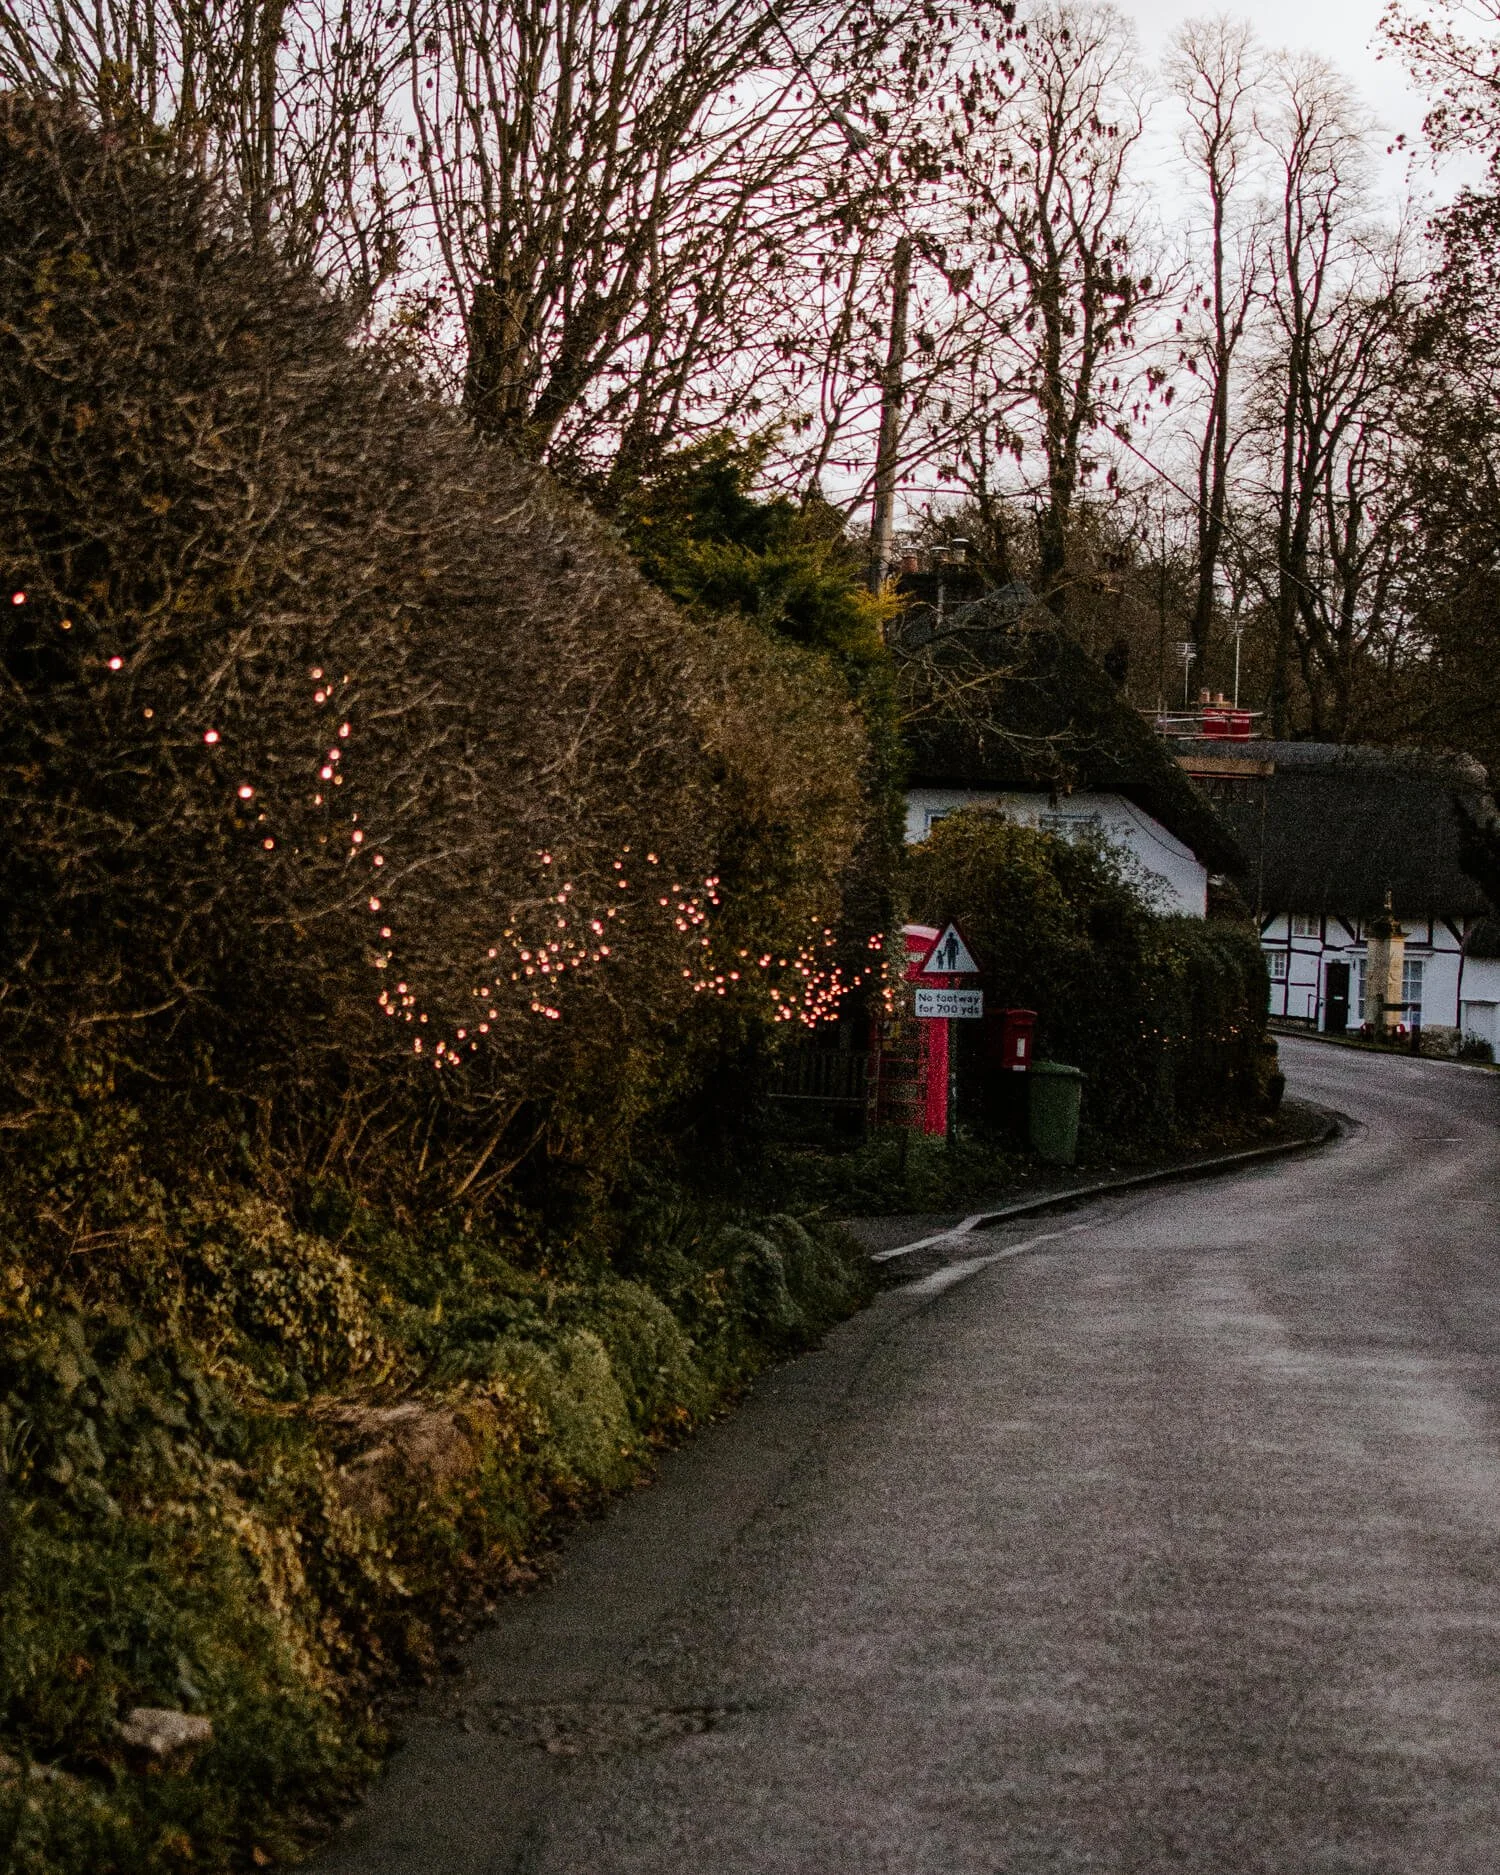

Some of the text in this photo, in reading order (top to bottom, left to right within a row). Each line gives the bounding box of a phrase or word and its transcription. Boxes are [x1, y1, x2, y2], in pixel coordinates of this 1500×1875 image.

[918, 993, 980, 1005] No footway
[919, 1004, 980, 1015] for 700 yds
